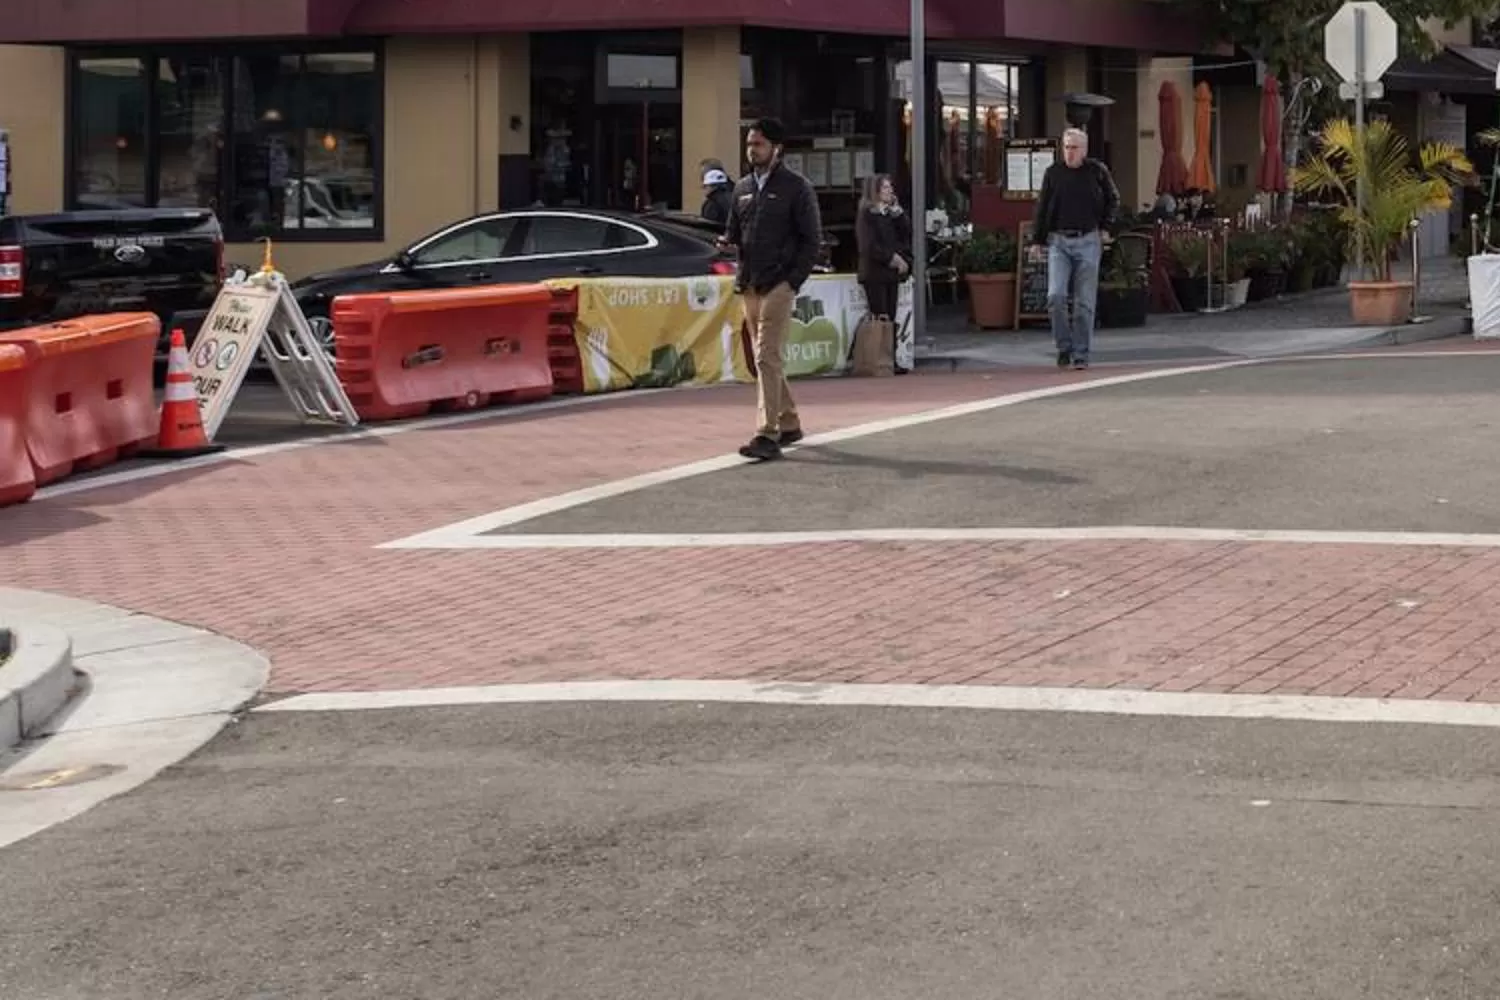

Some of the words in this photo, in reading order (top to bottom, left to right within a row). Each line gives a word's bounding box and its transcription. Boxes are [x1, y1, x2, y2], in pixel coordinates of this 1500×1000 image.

[609, 287, 650, 306] SHOP
[211, 315, 253, 336] WALK
[191, 374, 221, 396] OUR
